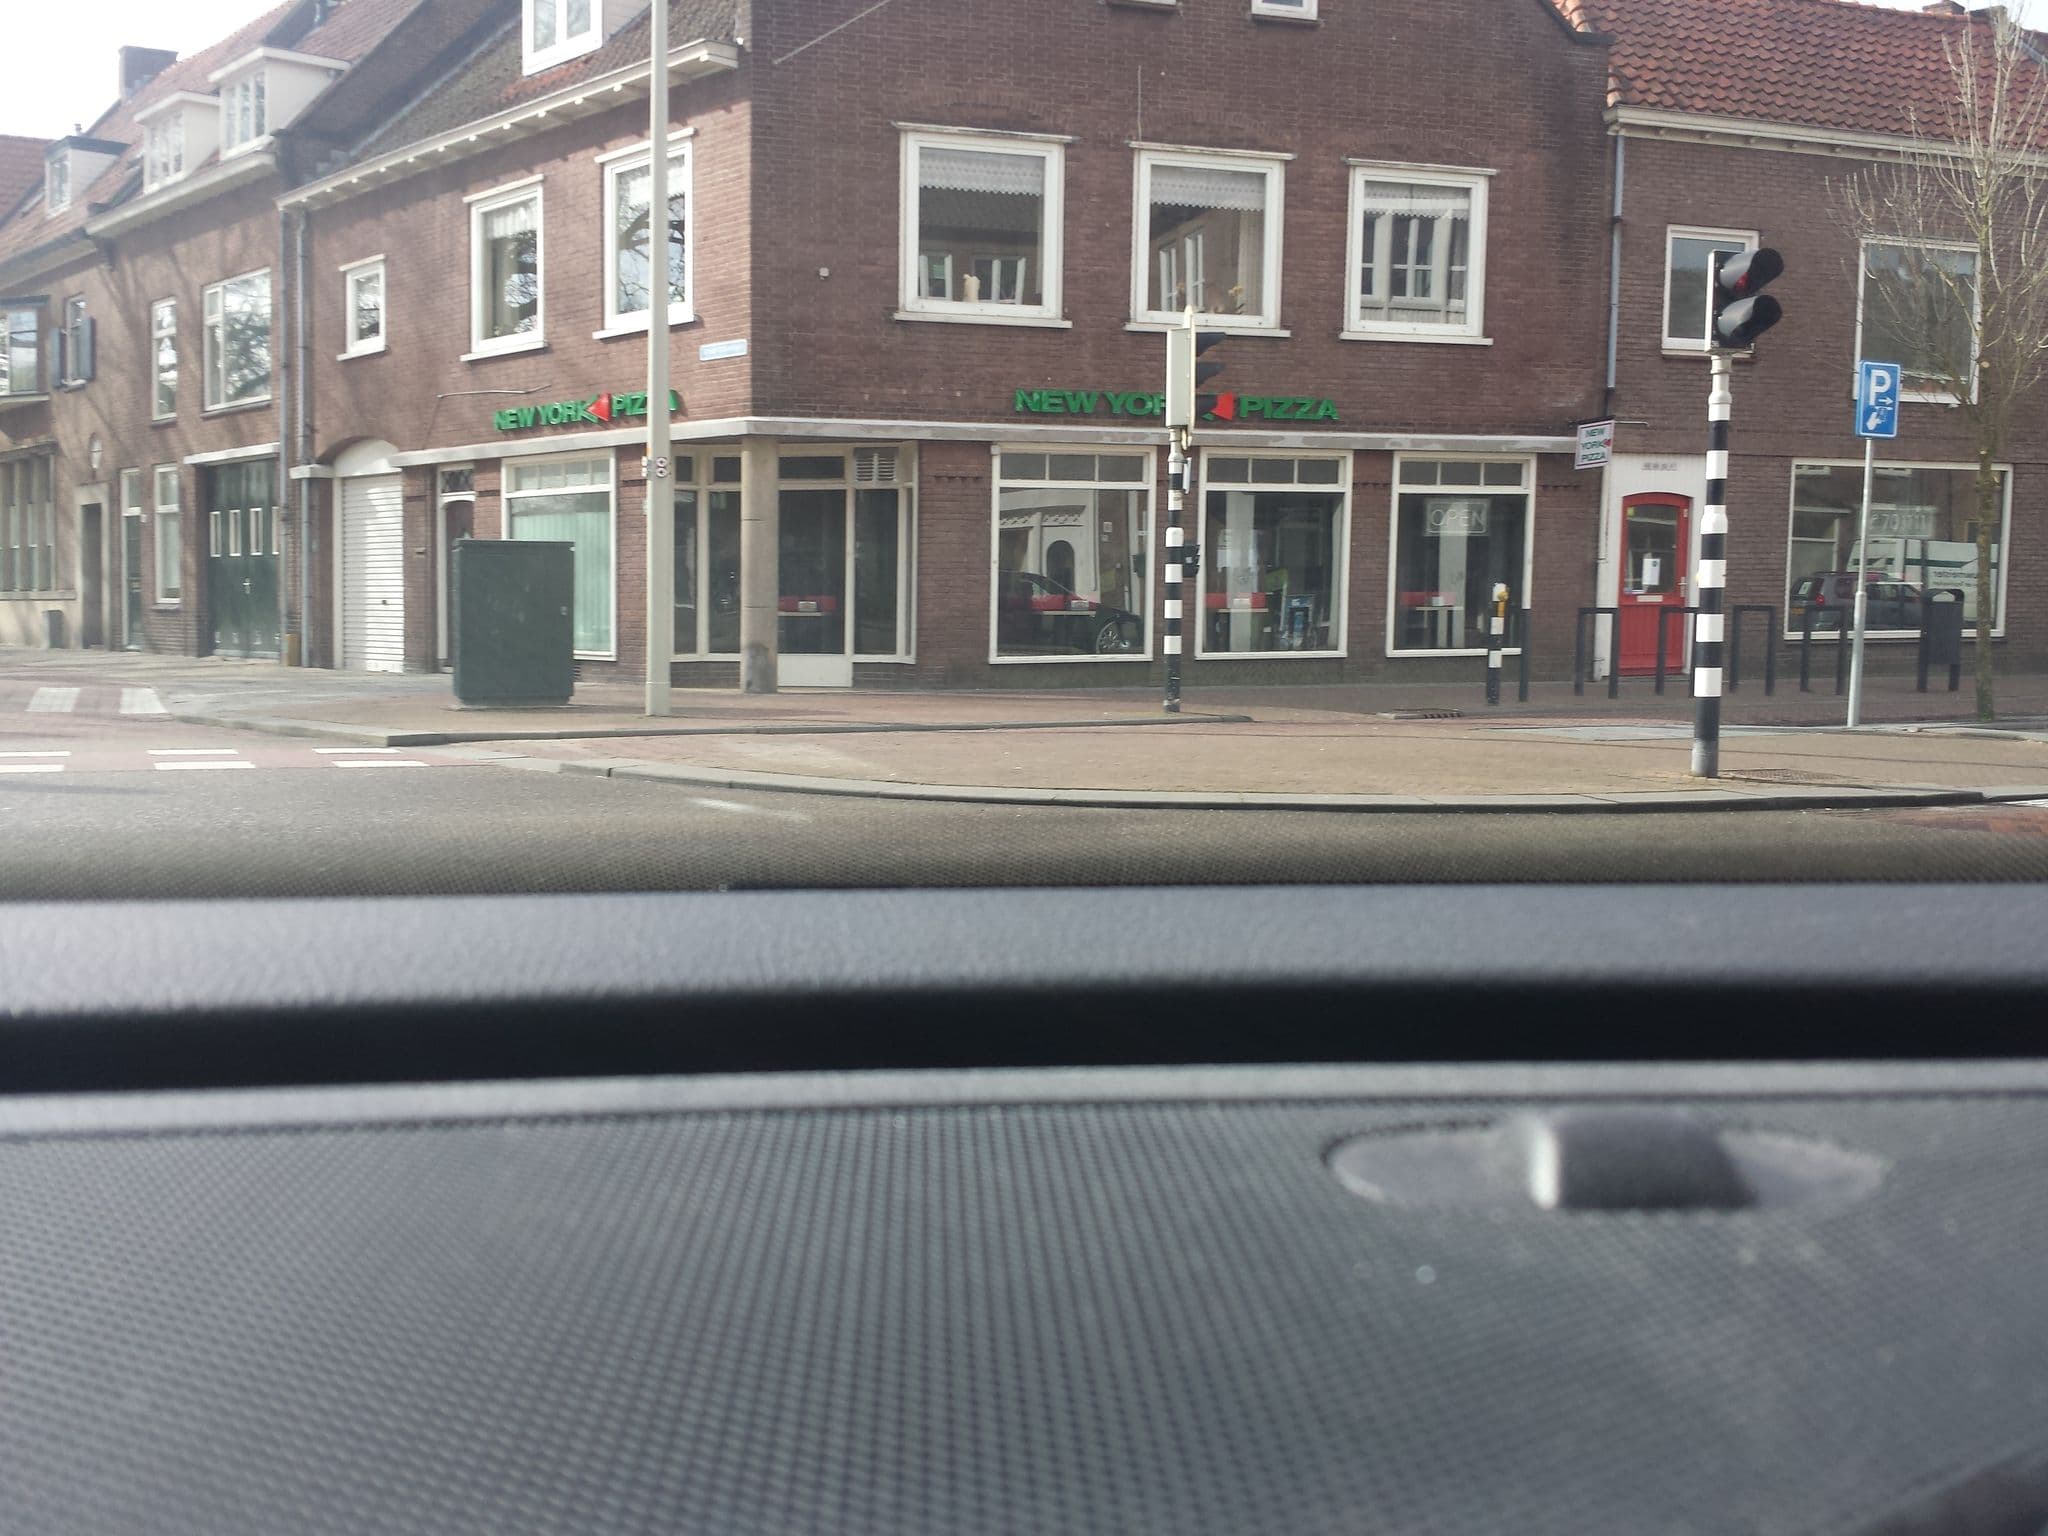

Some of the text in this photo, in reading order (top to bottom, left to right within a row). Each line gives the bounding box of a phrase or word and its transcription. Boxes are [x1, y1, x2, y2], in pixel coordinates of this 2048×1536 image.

[1869, 369, 1891, 406] P
[494, 406, 533, 430] NEW
[535, 394, 599, 425] YORK
[1015, 388, 1098, 413] NEW
[1239, 395, 1340, 420] PIZZA
[1585, 427, 1605, 438] NEW
[1581, 438, 1607, 450] YORK
[1581, 452, 1606, 462] PIZZA
[1431, 509, 1487, 528] OPEN
